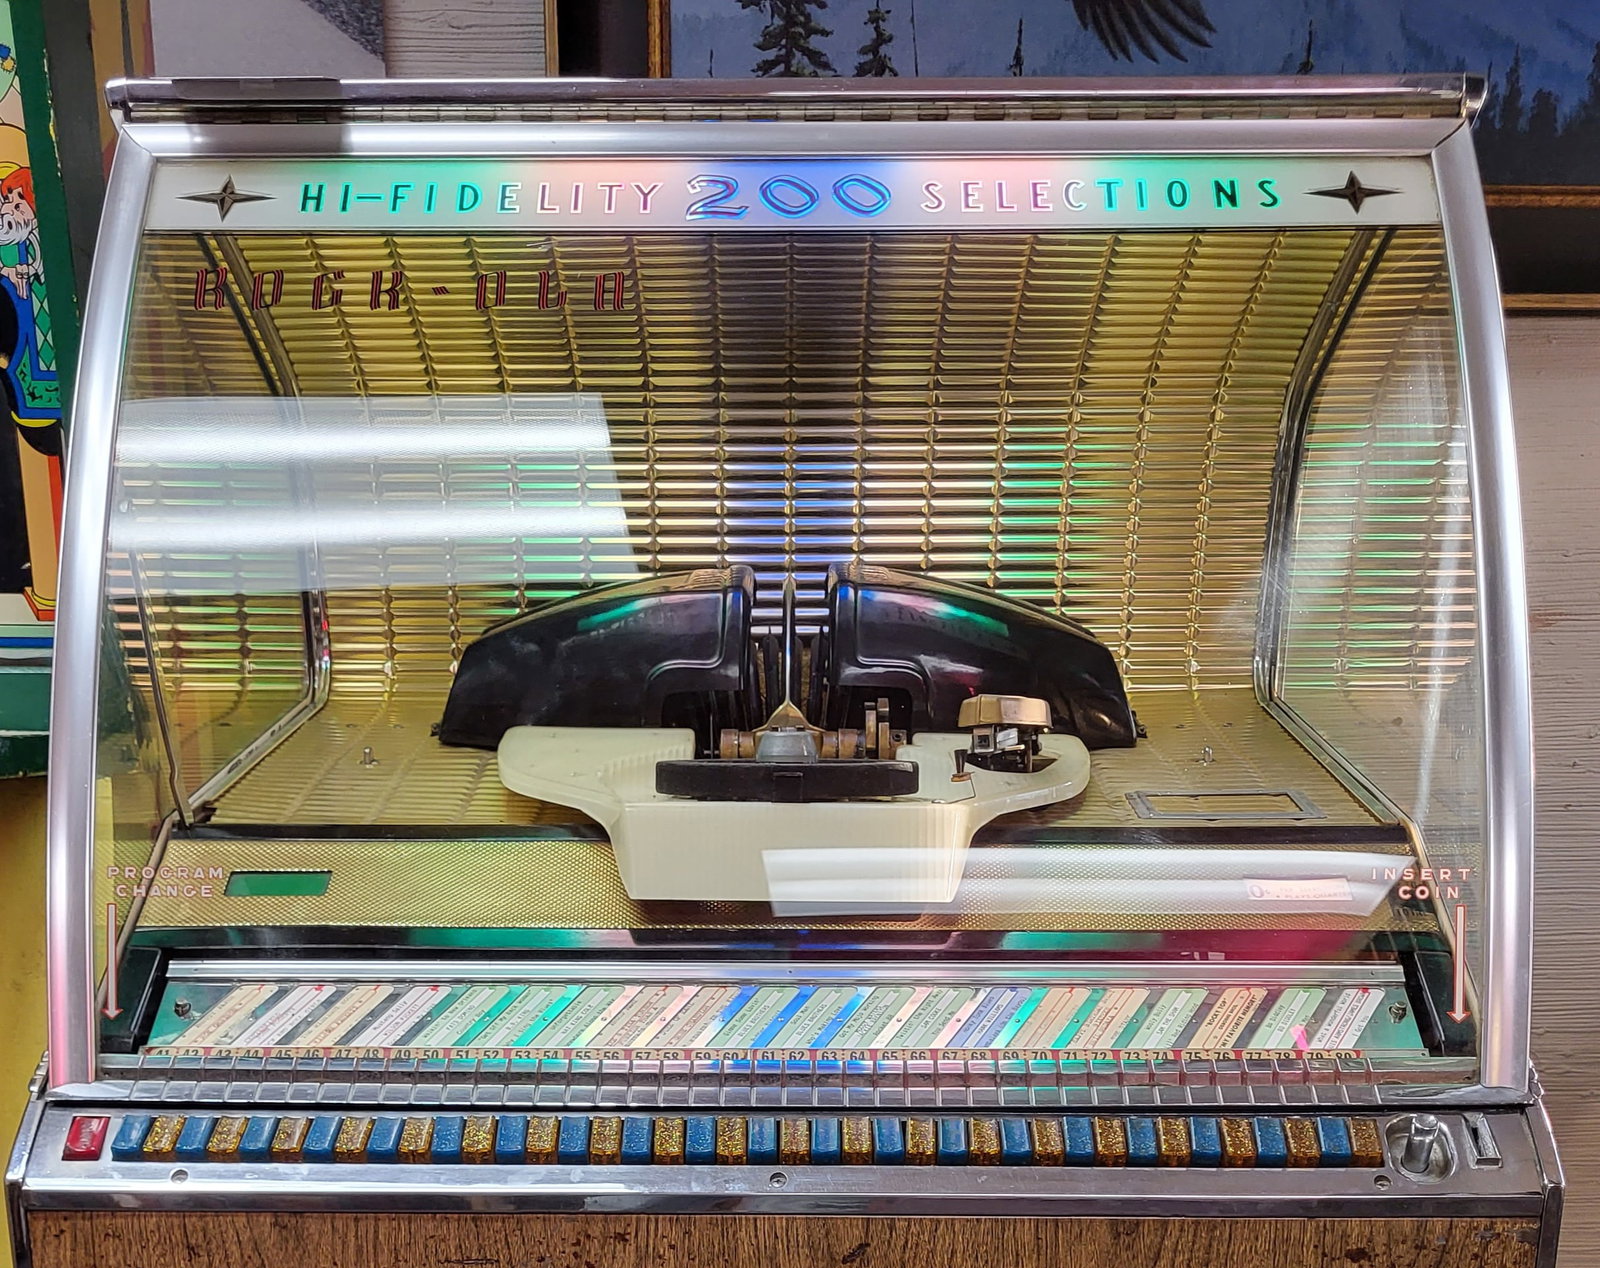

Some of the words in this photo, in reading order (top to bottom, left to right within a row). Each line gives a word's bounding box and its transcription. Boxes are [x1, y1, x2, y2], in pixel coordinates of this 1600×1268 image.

[300, 182, 664, 214] HI-FIDELITY
[684, 172, 892, 220] 200
[920, 178, 1281, 213] SELECTIONS
[107, 866, 224, 879] PROGRAM
[1371, 868, 1471, 881] INSERT
[116, 884, 214, 898] CHANGE
[1398, 886, 1460, 899] COIN
[363, 1050, 379, 1058] 48
[395, 1050, 411, 1058] 49
[423, 1050, 438, 1058] 50
[455, 1050, 469, 1058] 51
[483, 1050, 499, 1058] 52
[515, 1050, 531, 1059] 53
[543, 1050, 558, 1059] 54
[575, 1050, 591, 1059] 55
[603, 1050, 619, 1059] 56
[635, 1050, 651, 1059] 57
[663, 1050, 679, 1059] 58
[695, 1050, 711, 1059] 59
[723, 1050, 739, 1059] 60
[761, 1050, 775, 1059] 61
[789, 1050, 805, 1059] 62
[821, 1051, 837, 1060] 63
[850, 1051, 865, 1060] 64
[882, 1051, 898, 1060] 65
[910, 1051, 926, 1060] 66
[942, 1051, 958, 1060] 67
[971, 1051, 986, 1060] 68
[1003, 1051, 1019, 1060] 69
[1031, 1051, 1047, 1060] 70
[1064, 1051, 1078, 1060] 71
[1091, 1051, 1107, 1060] 72
[1188, 1052, 1202, 1060] 75
[1214, 1052, 1230, 1060] 76
[1275, 1052, 1290, 1060] 78
